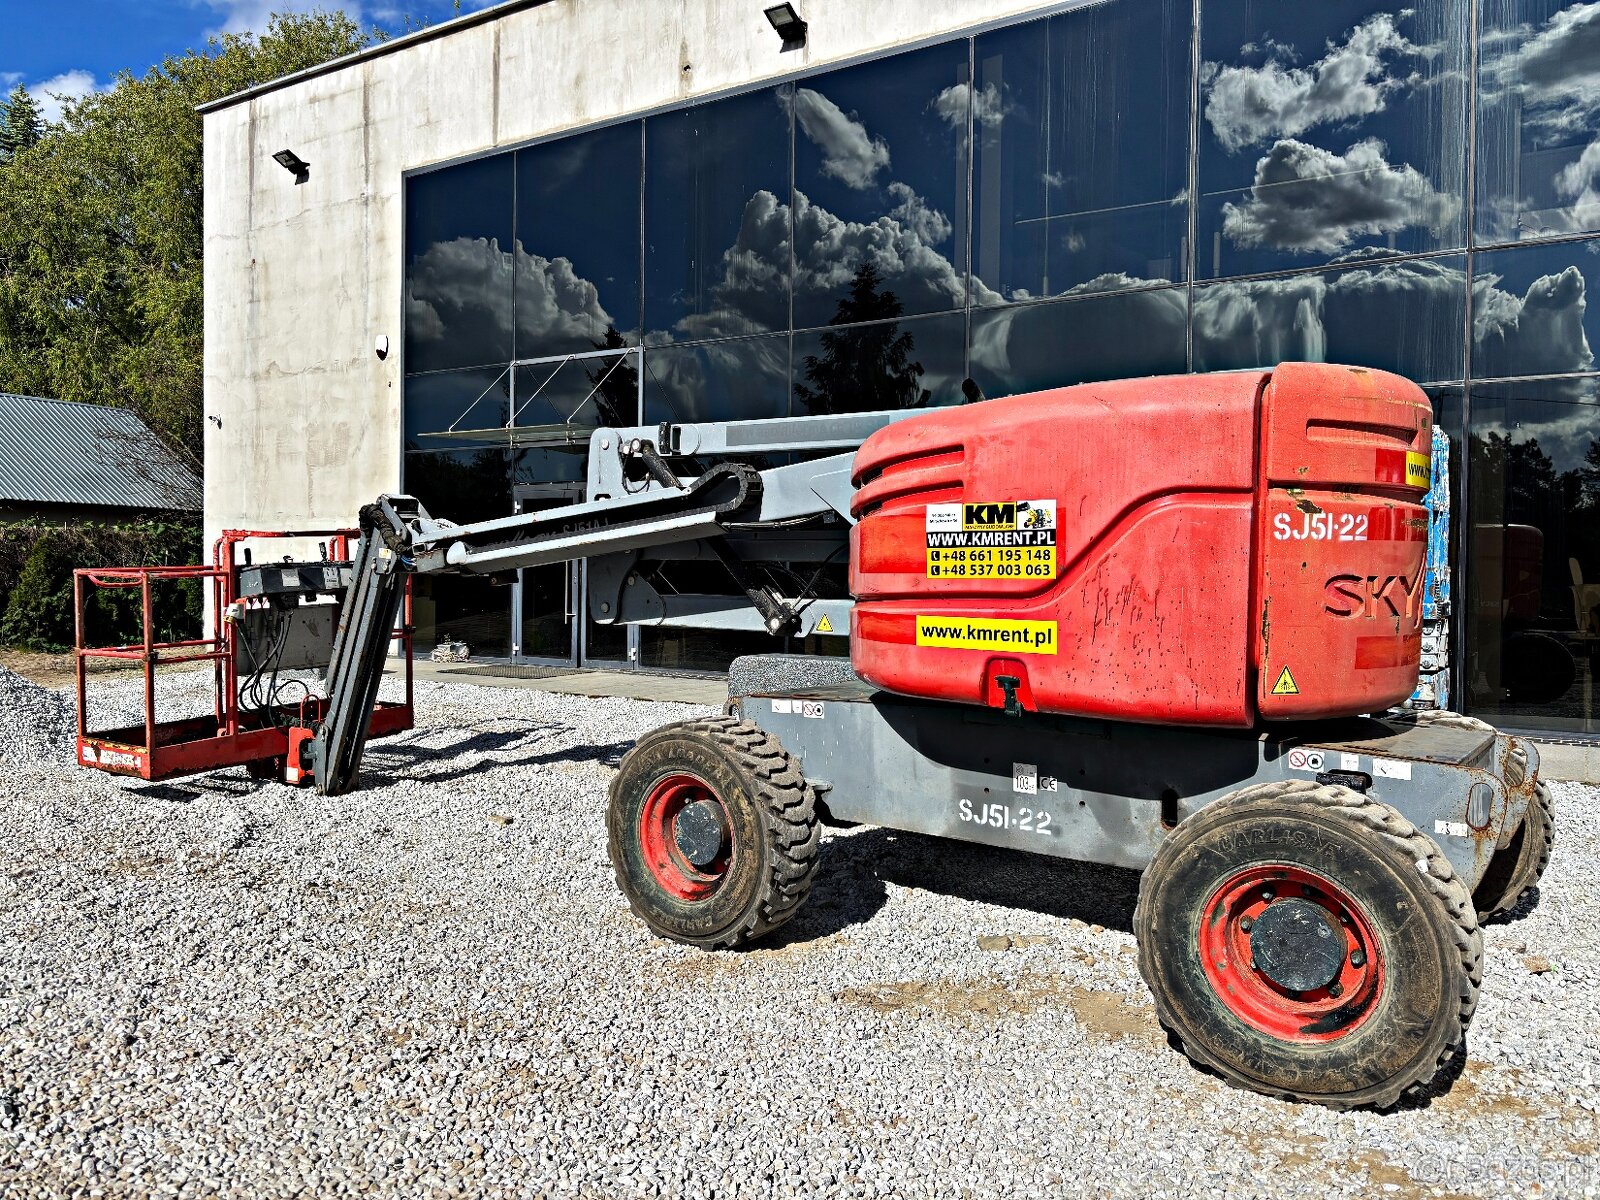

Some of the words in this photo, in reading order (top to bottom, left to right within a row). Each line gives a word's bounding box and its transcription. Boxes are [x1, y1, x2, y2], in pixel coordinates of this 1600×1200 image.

[966, 504, 1014, 524] KM
[928, 531, 1055, 546] WWW.KMRENT.PL
[943, 550, 966, 561] +48
[970, 550, 993, 561] 661
[998, 550, 1021, 560] 195
[1026, 550, 1051, 560] 148
[943, 565, 966, 575] +48
[970, 565, 993, 575] 537
[997, 565, 1021, 575] 003
[1025, 565, 1050, 575] 063
[921, 624, 1052, 647] www.kmrent.pl
[1015, 776, 1029, 791] 103
